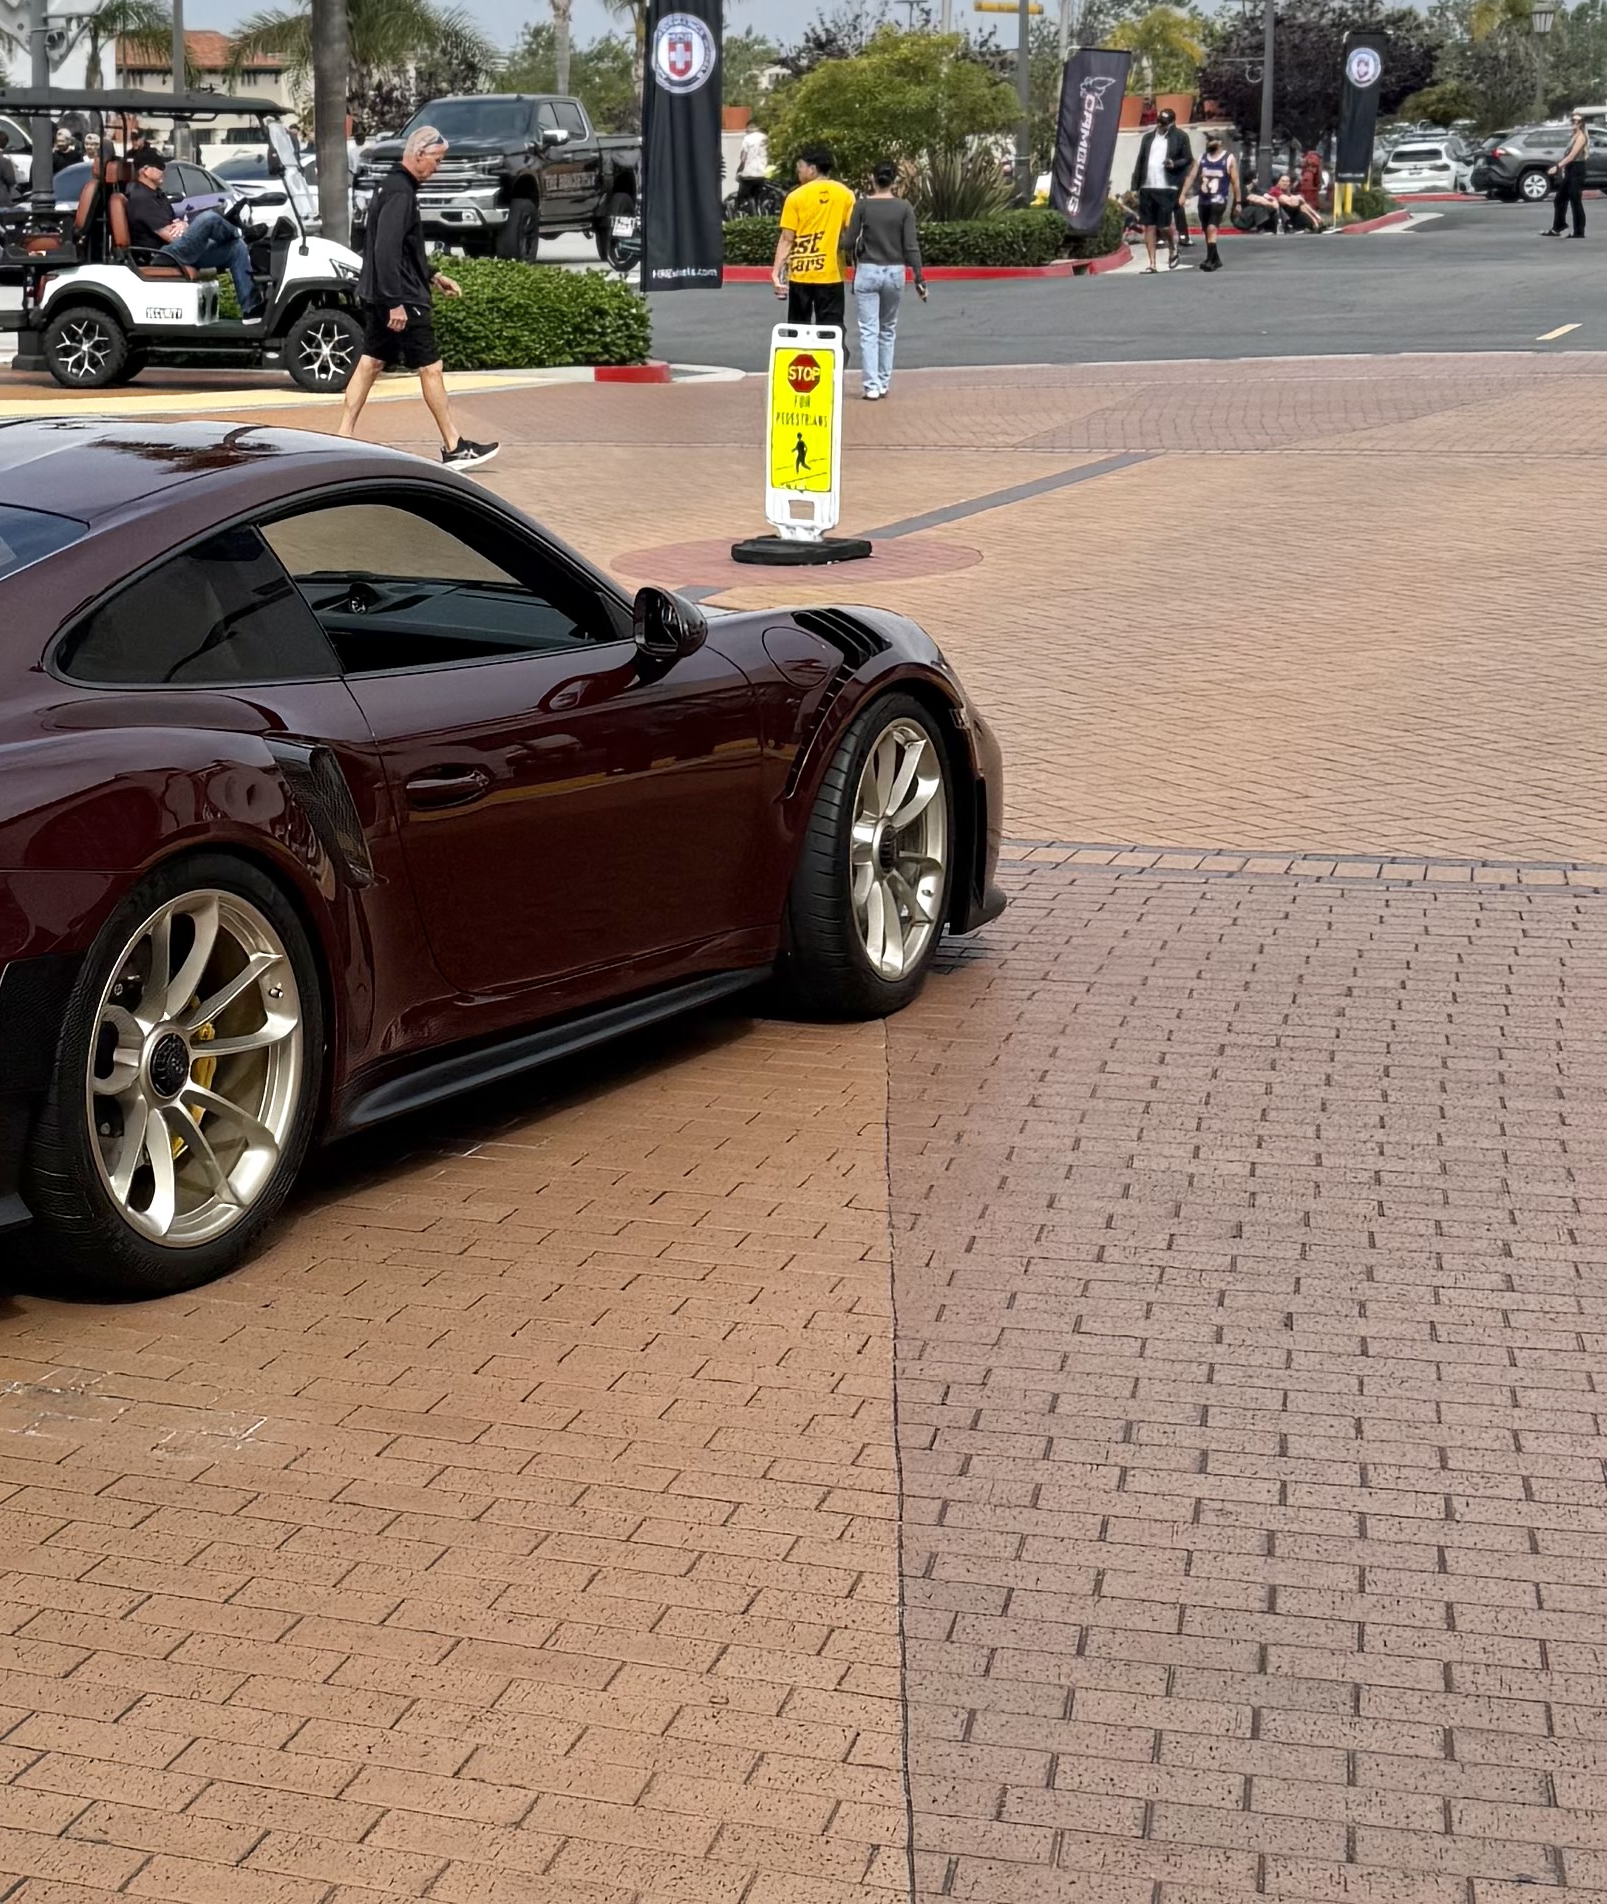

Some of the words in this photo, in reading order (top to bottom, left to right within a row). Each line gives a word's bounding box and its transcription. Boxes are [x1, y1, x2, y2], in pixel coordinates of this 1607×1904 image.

[788, 365, 821, 382] STOP
[794, 395, 811, 408] FOR
[776, 411, 828, 428] PEDESTRIANS
